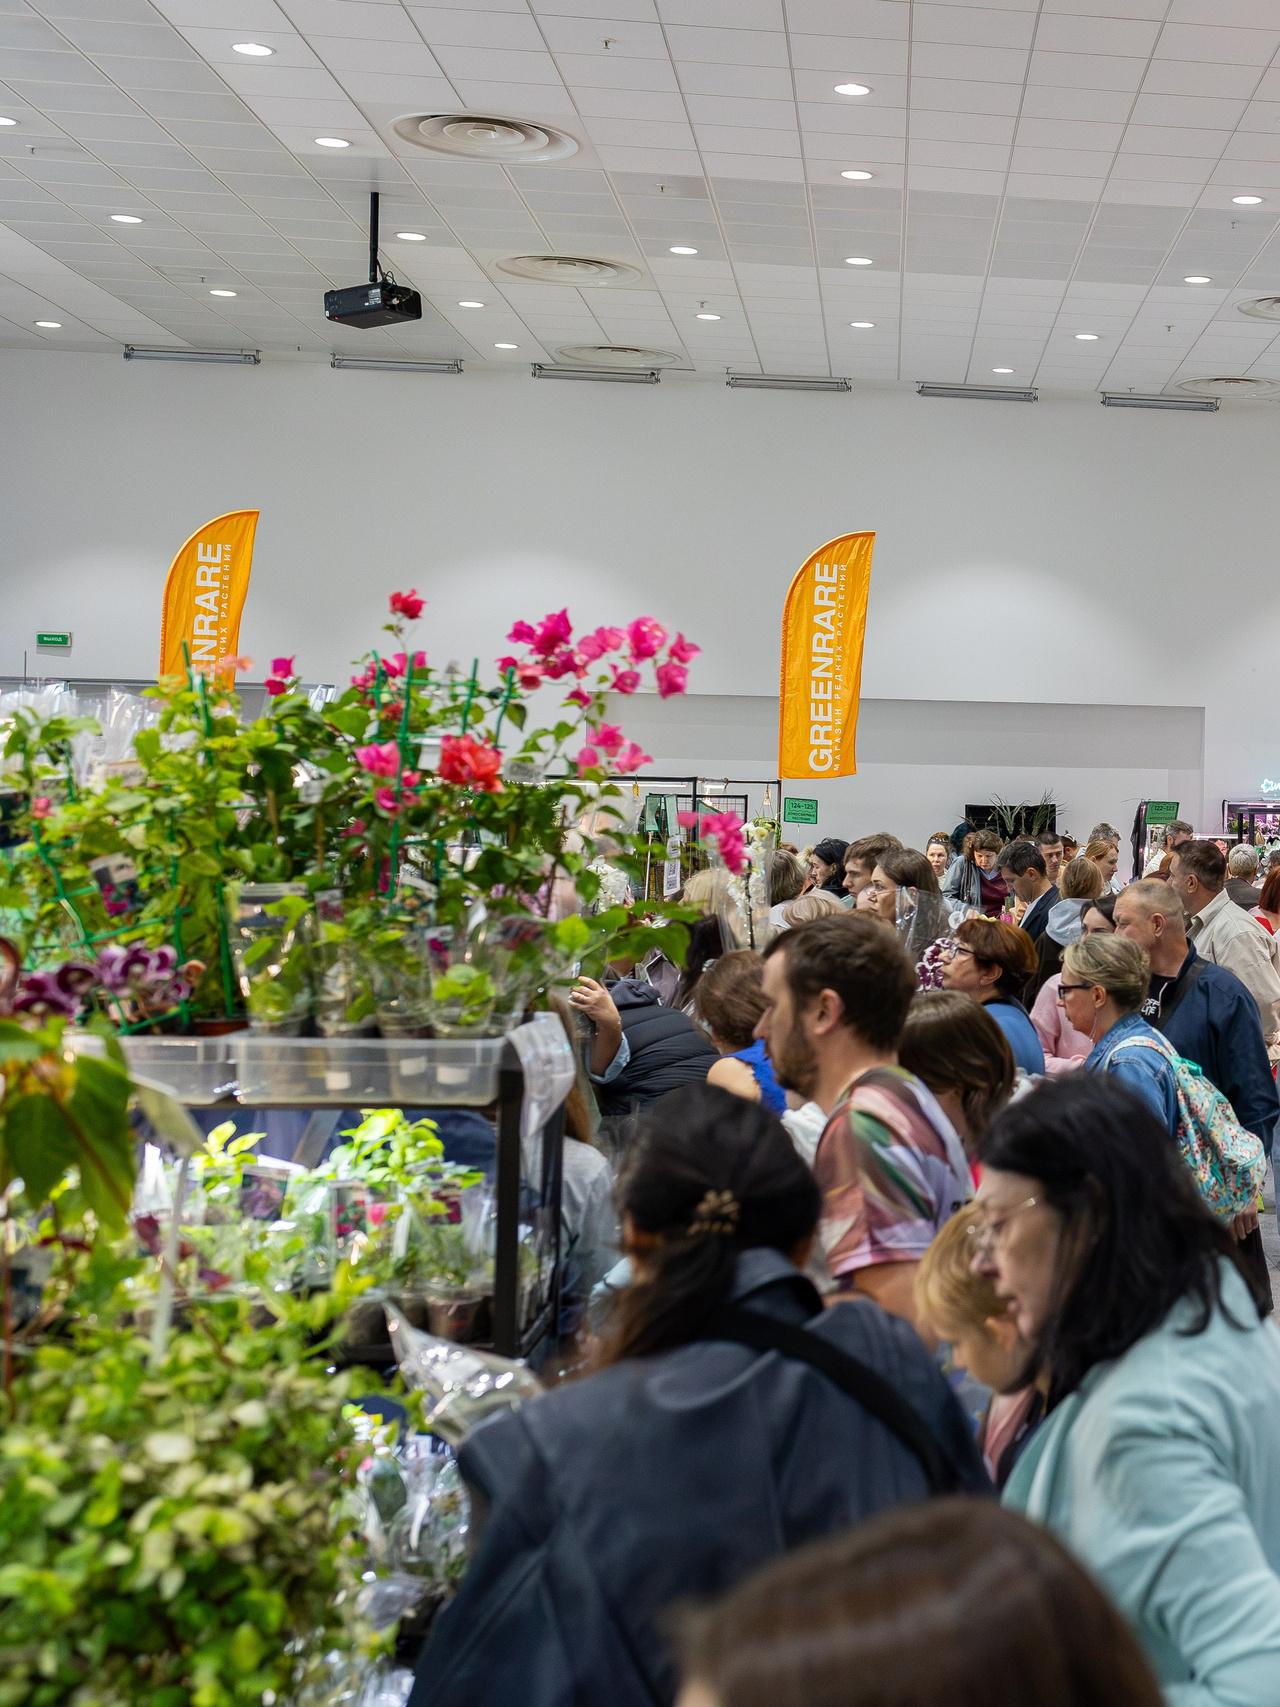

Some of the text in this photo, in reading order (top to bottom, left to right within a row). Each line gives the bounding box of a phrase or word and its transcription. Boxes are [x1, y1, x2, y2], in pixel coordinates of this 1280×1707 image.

[192, 542, 222, 696] ENRARE
[218, 543, 232, 664] ДКИХ РАСТЕНИЙ
[808, 561, 838, 772] GREENRARE
[833, 564, 847, 771] МАГАЗИН РЕДКИХ РАСТЕНИЙ
[790, 802, 814, 810] 124-125
